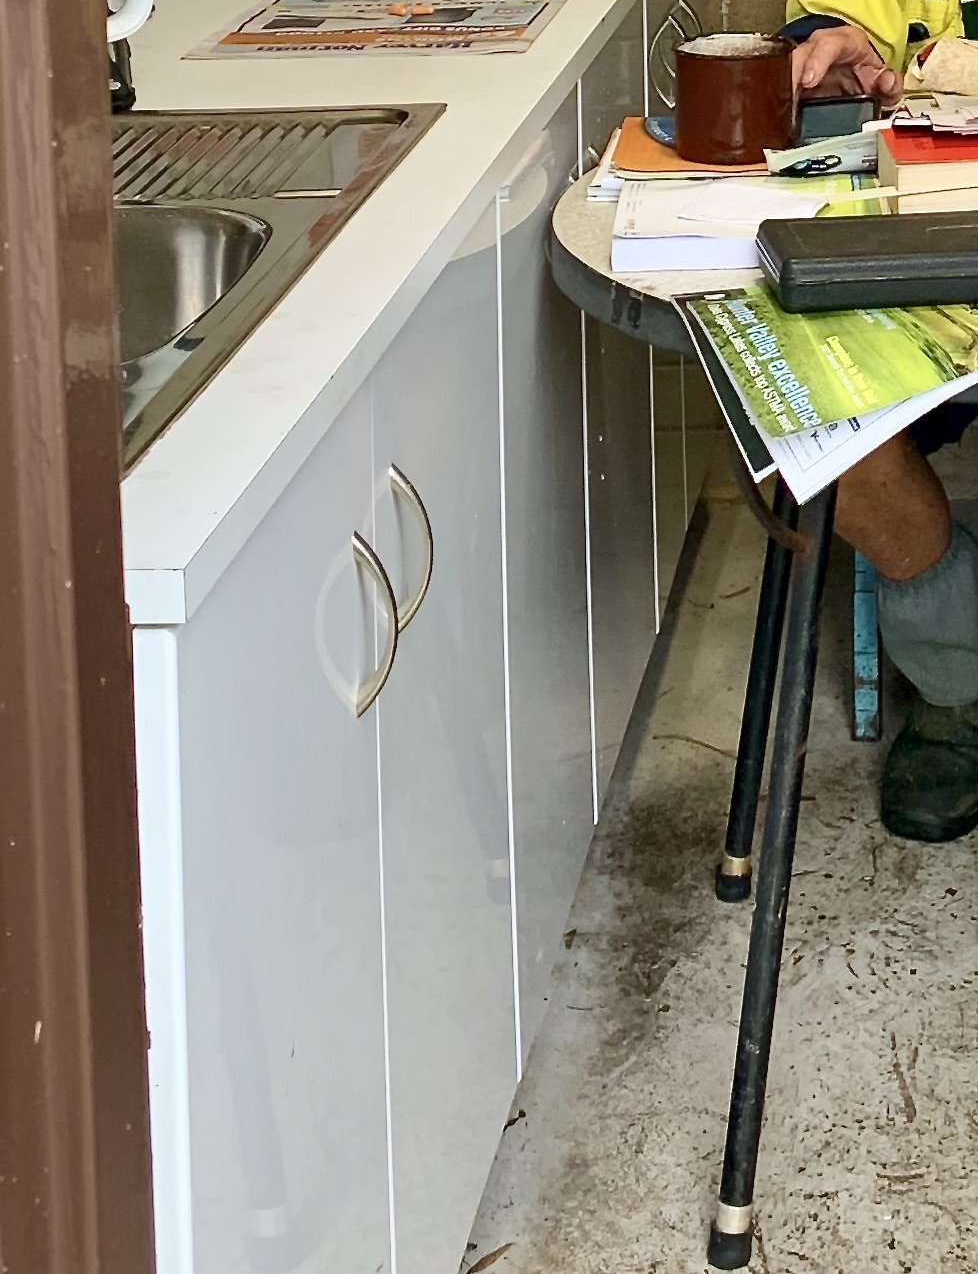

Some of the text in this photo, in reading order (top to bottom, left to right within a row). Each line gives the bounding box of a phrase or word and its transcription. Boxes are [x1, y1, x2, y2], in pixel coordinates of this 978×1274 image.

[729, 331, 747, 354] Lakes
[739, 349, 762, 378] collects
[754, 373, 768, 390] top
[745, 323, 782, 361] Valley
[767, 357, 822, 428] excellence
